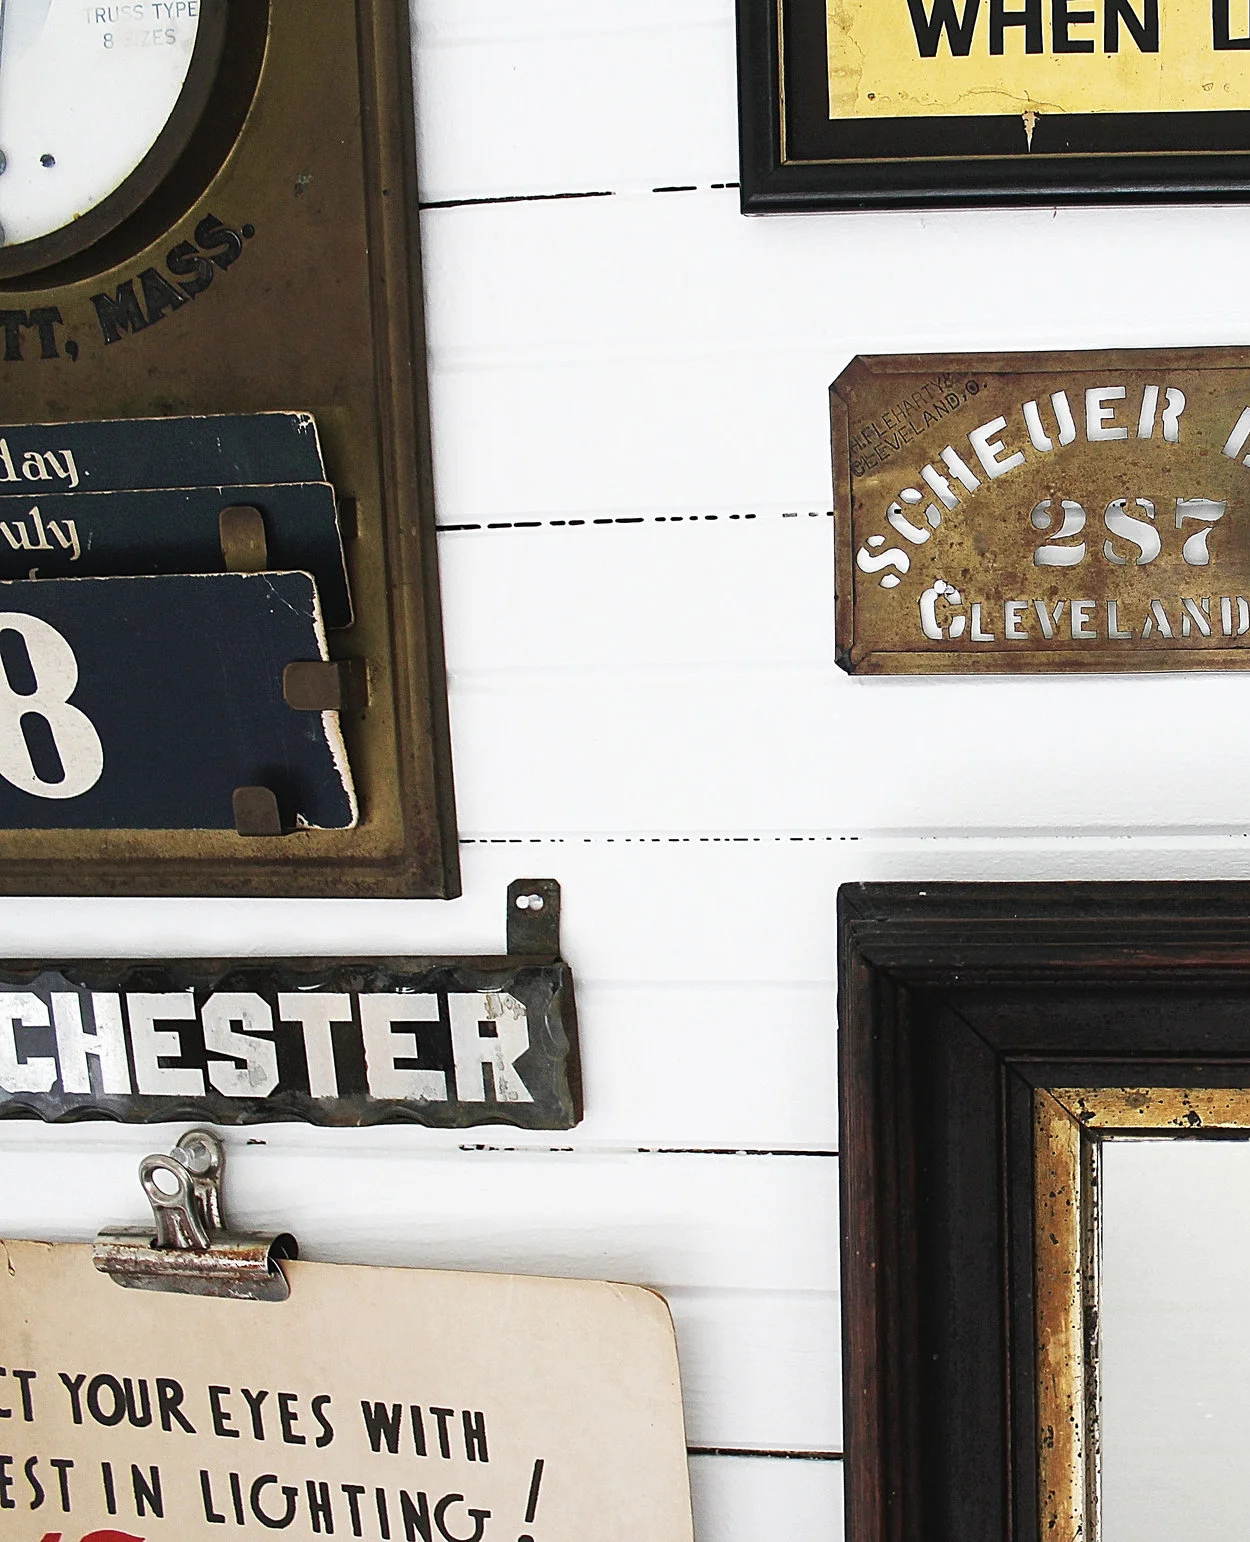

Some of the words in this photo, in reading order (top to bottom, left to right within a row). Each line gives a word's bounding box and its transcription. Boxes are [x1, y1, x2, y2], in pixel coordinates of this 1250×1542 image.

[83, 4, 144, 24] TRUSS
[152, 0, 198, 20] TYPE
[103, 32, 114, 49] 8
[907, 0, 1160, 58] WHEN
[89, 212, 256, 346] MASS.
[856, 384, 1187, 588] SCHEUER
[57, 1372, 197, 1435] YOUR
[209, 1384, 335, 1448] EYES
[361, 1400, 489, 1463] WITH
[101, 1461, 164, 1519] IN
